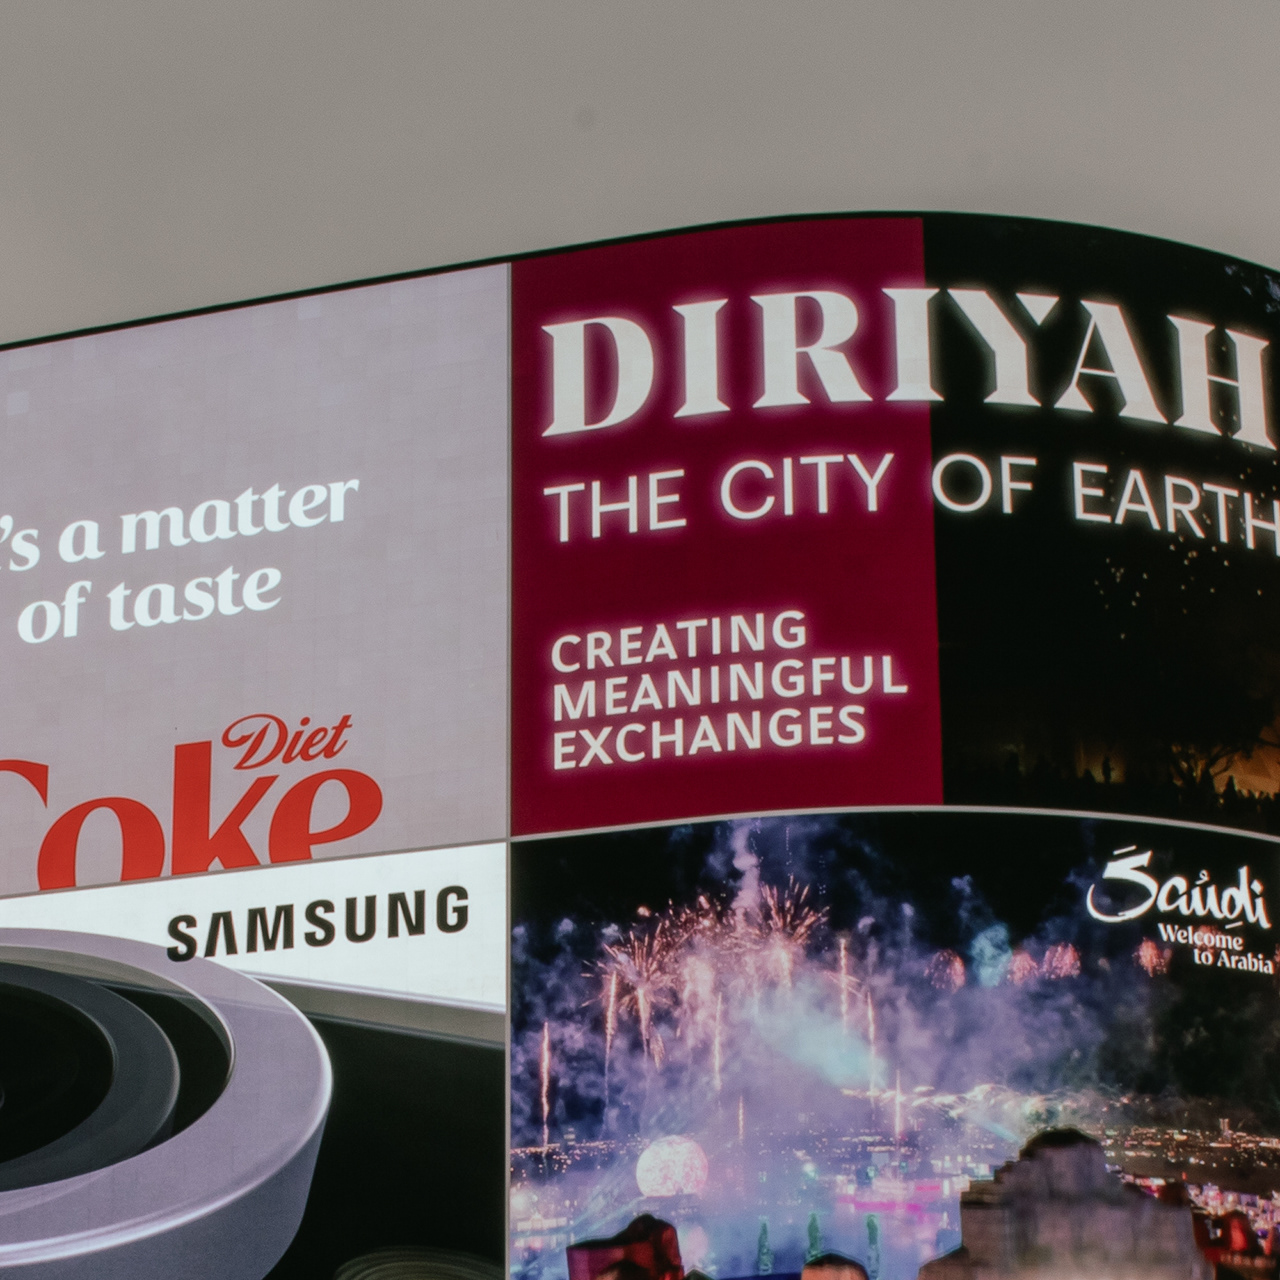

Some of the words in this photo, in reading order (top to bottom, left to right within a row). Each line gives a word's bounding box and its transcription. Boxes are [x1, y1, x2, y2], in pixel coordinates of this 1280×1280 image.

[541, 287, 1278, 450] DIRIYAH
[58, 519, 106, 563] a
[120, 478, 360, 554] matter
[543, 469, 687, 543] THE
[720, 453, 894, 520] CITY
[931, 453, 1037, 515] OF
[17, 580, 91, 643] of
[107, 566, 282, 631] taste
[550, 609, 807, 673] CREATING
[553, 655, 908, 722] MEANINGFUL
[221, 713, 353, 770] Diet
[553, 705, 867, 770] EXCHANGES
[167, 885, 469, 962] SAMSUNG
[1158, 922, 1244, 951] Welcome
[1193, 948, 1214, 966] to
[1217, 950, 1274, 975] Arabia
